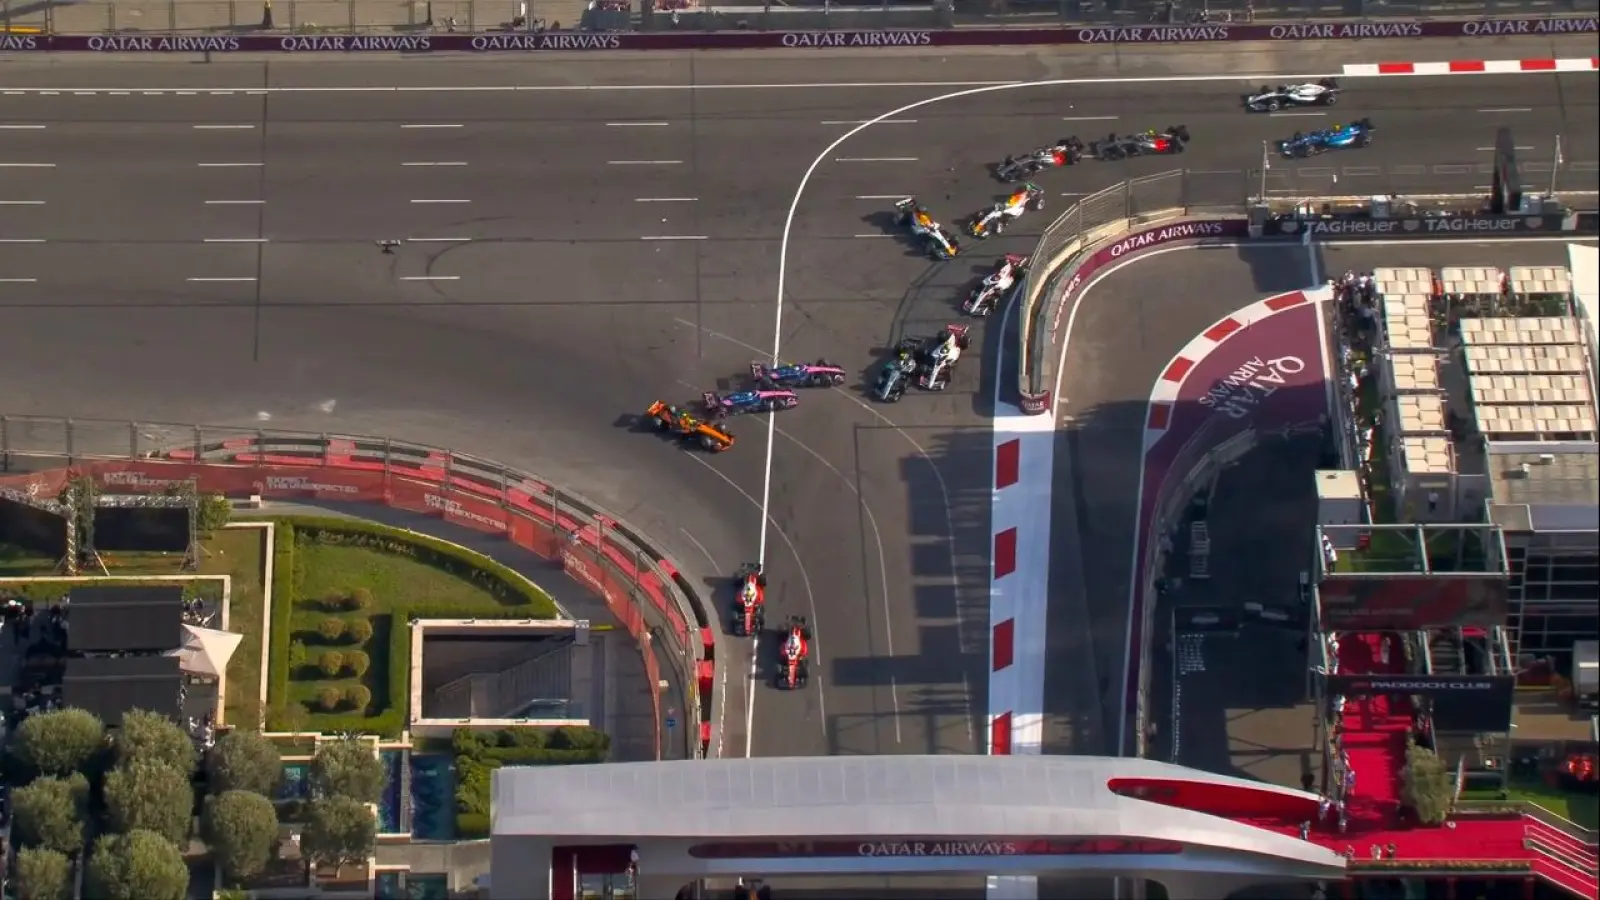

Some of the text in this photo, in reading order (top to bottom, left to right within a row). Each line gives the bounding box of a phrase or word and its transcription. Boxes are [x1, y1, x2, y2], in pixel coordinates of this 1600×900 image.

[1078, 27, 1229, 42] QATAR AIRWAYS
[1269, 24, 1422, 38] QATAR AIRWAYS
[1462, 20, 1528, 35] QATAR
[0, 36, 36, 49] AYS
[87, 36, 240, 50] QATAR AIRWAYS
[281, 36, 430, 50] QATAR AIRWAYS
[471, 35, 620, 50] QATAR AIRWAYS
[782, 32, 931, 47] QATAR AIRWAYS
[1425, 219, 1520, 231] TAGHeuer
[1111, 223, 1223, 256] QATAR AIRWAYS
[1198, 355, 1265, 407] AIRWAYS
[1216, 356, 1305, 418] QATAR
[1371, 681, 1446, 689] PADDOCK
[1450, 681, 1491, 689] CLUB
[859, 841, 1016, 856] QATAR AIRWAYS
